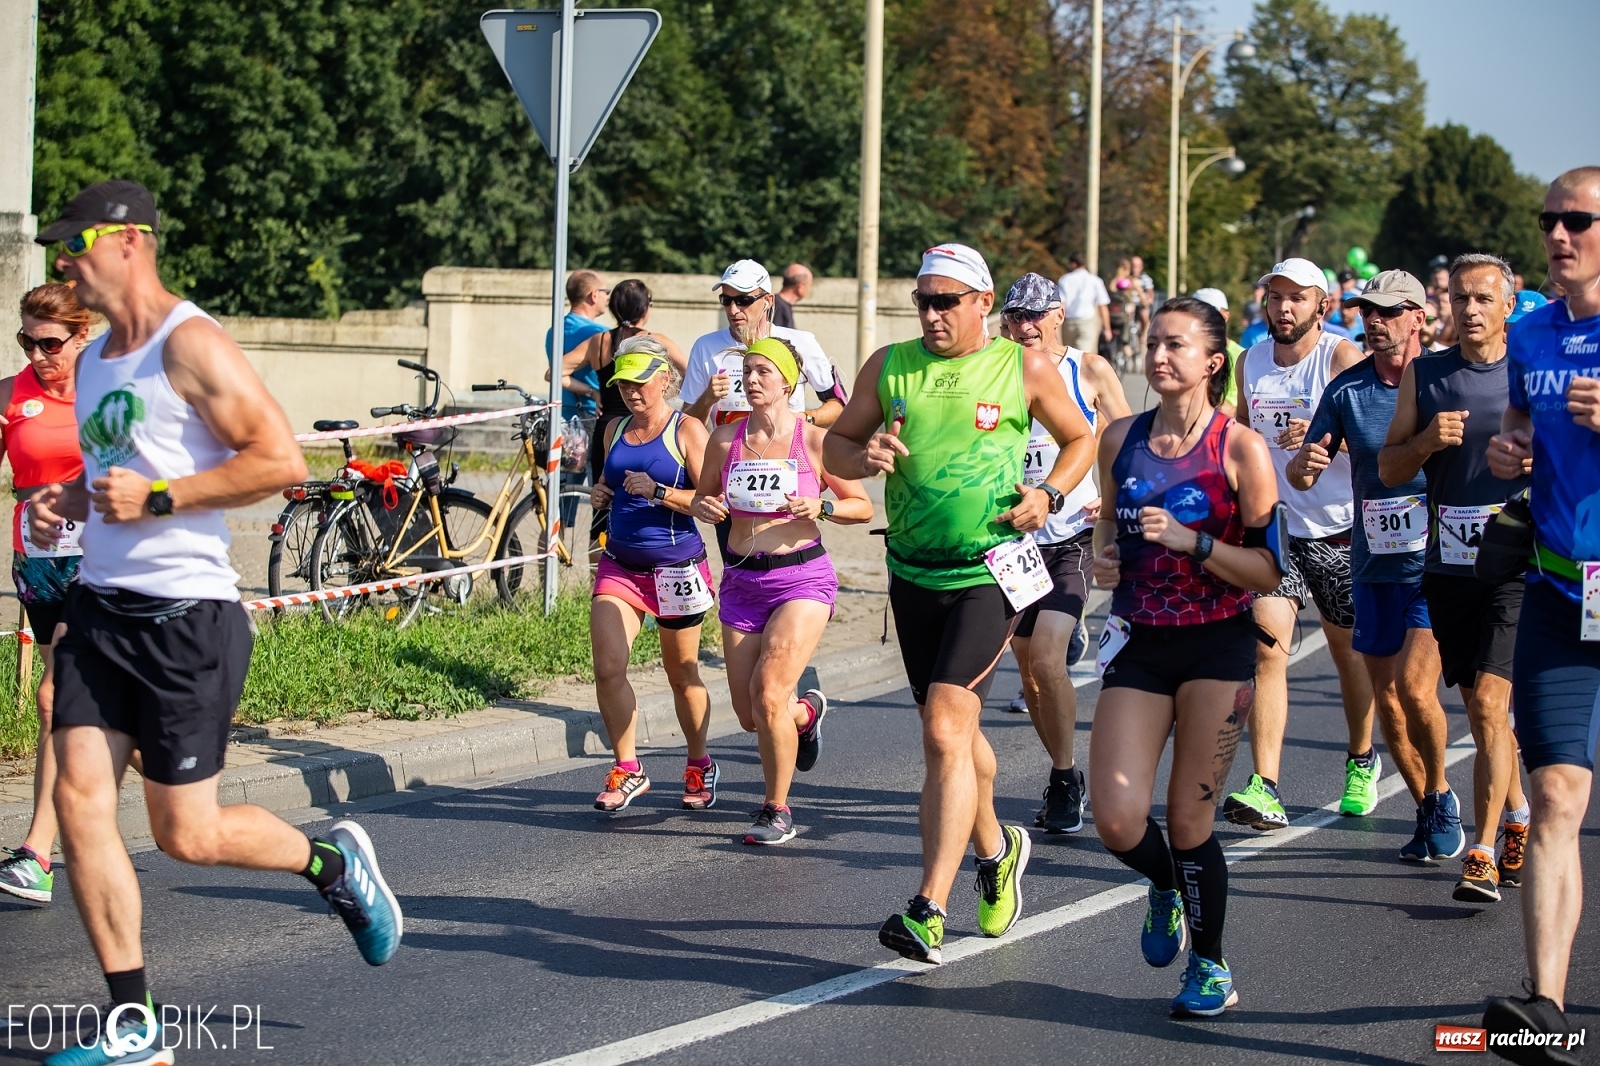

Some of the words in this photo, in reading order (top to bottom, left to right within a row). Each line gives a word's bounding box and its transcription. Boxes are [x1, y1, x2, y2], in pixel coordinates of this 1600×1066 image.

[934, 378, 960, 390] Gryf
[746, 474, 780, 491] 272
[1379, 512, 1411, 532] 301
[1459, 522, 1485, 543] 15
[673, 577, 701, 596] 231
[1177, 860, 1203, 932] kalenji
